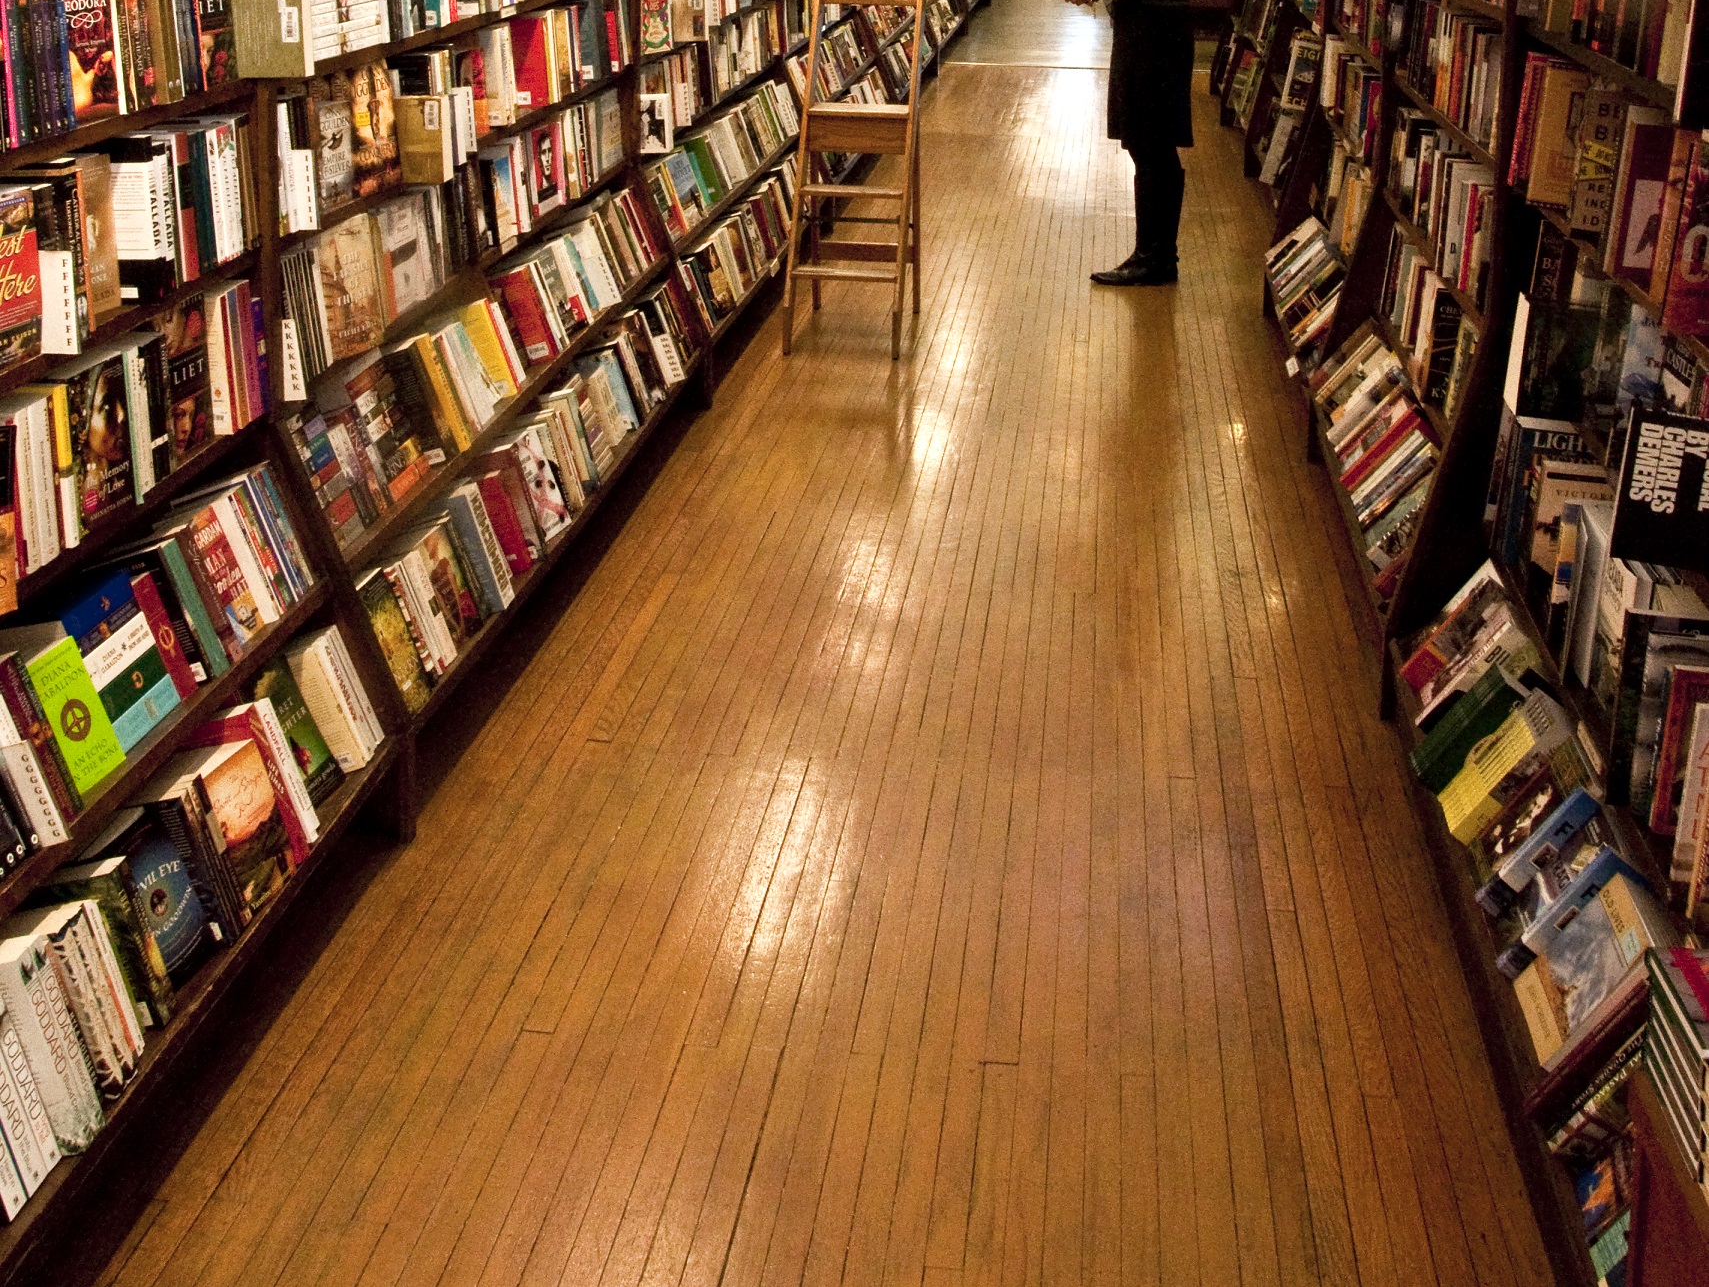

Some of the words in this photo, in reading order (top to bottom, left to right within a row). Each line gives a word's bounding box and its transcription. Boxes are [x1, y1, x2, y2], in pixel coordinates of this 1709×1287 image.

[149, 189, 161, 246] FALLADA
[162, 192, 173, 248] FALLADA
[62, 259, 69, 268] F
[63, 272, 69, 281] F
[63, 285, 69, 294] F
[64, 298, 70, 307] F
[65, 312, 71, 320] F
[284, 322, 291, 330] K
[66, 325, 72, 334] F
[67, 338, 72, 346] F
[288, 353, 295, 361] K
[290, 363, 297, 371] K
[291, 373, 299, 381] K
[293, 383, 300, 391] K
[1686, 430, 1709, 461] BY
[100, 460, 131, 482] Memory
[1629, 422, 1665, 502] DEMERS
[1650, 426, 1687, 514] CHARLES
[107, 478, 126, 495] Love
[193, 520, 223, 549] GARDAM
[203, 546, 227, 574] MAN
[213, 564, 244, 594] ooden
[39, 661, 72, 686] DIANA
[261, 712, 287, 765] LANDFALL
[83, 739, 108, 763] ECHO
[21, 755, 29, 763] G
[26, 766, 34, 774] G
[30, 775, 38, 783] G
[34, 786, 42, 795] G
[39, 797, 47, 805] G
[43, 808, 51, 816] G
[48, 818, 56, 826] G
[53, 829, 60, 837] G
[159, 859, 181, 878] EYE
[1601, 889, 1615, 908] OLD
[42, 975, 81, 1059] GODDARD
[28, 989, 69, 1074] GODDARD
[0, 1028, 43, 1119] GODDARD
